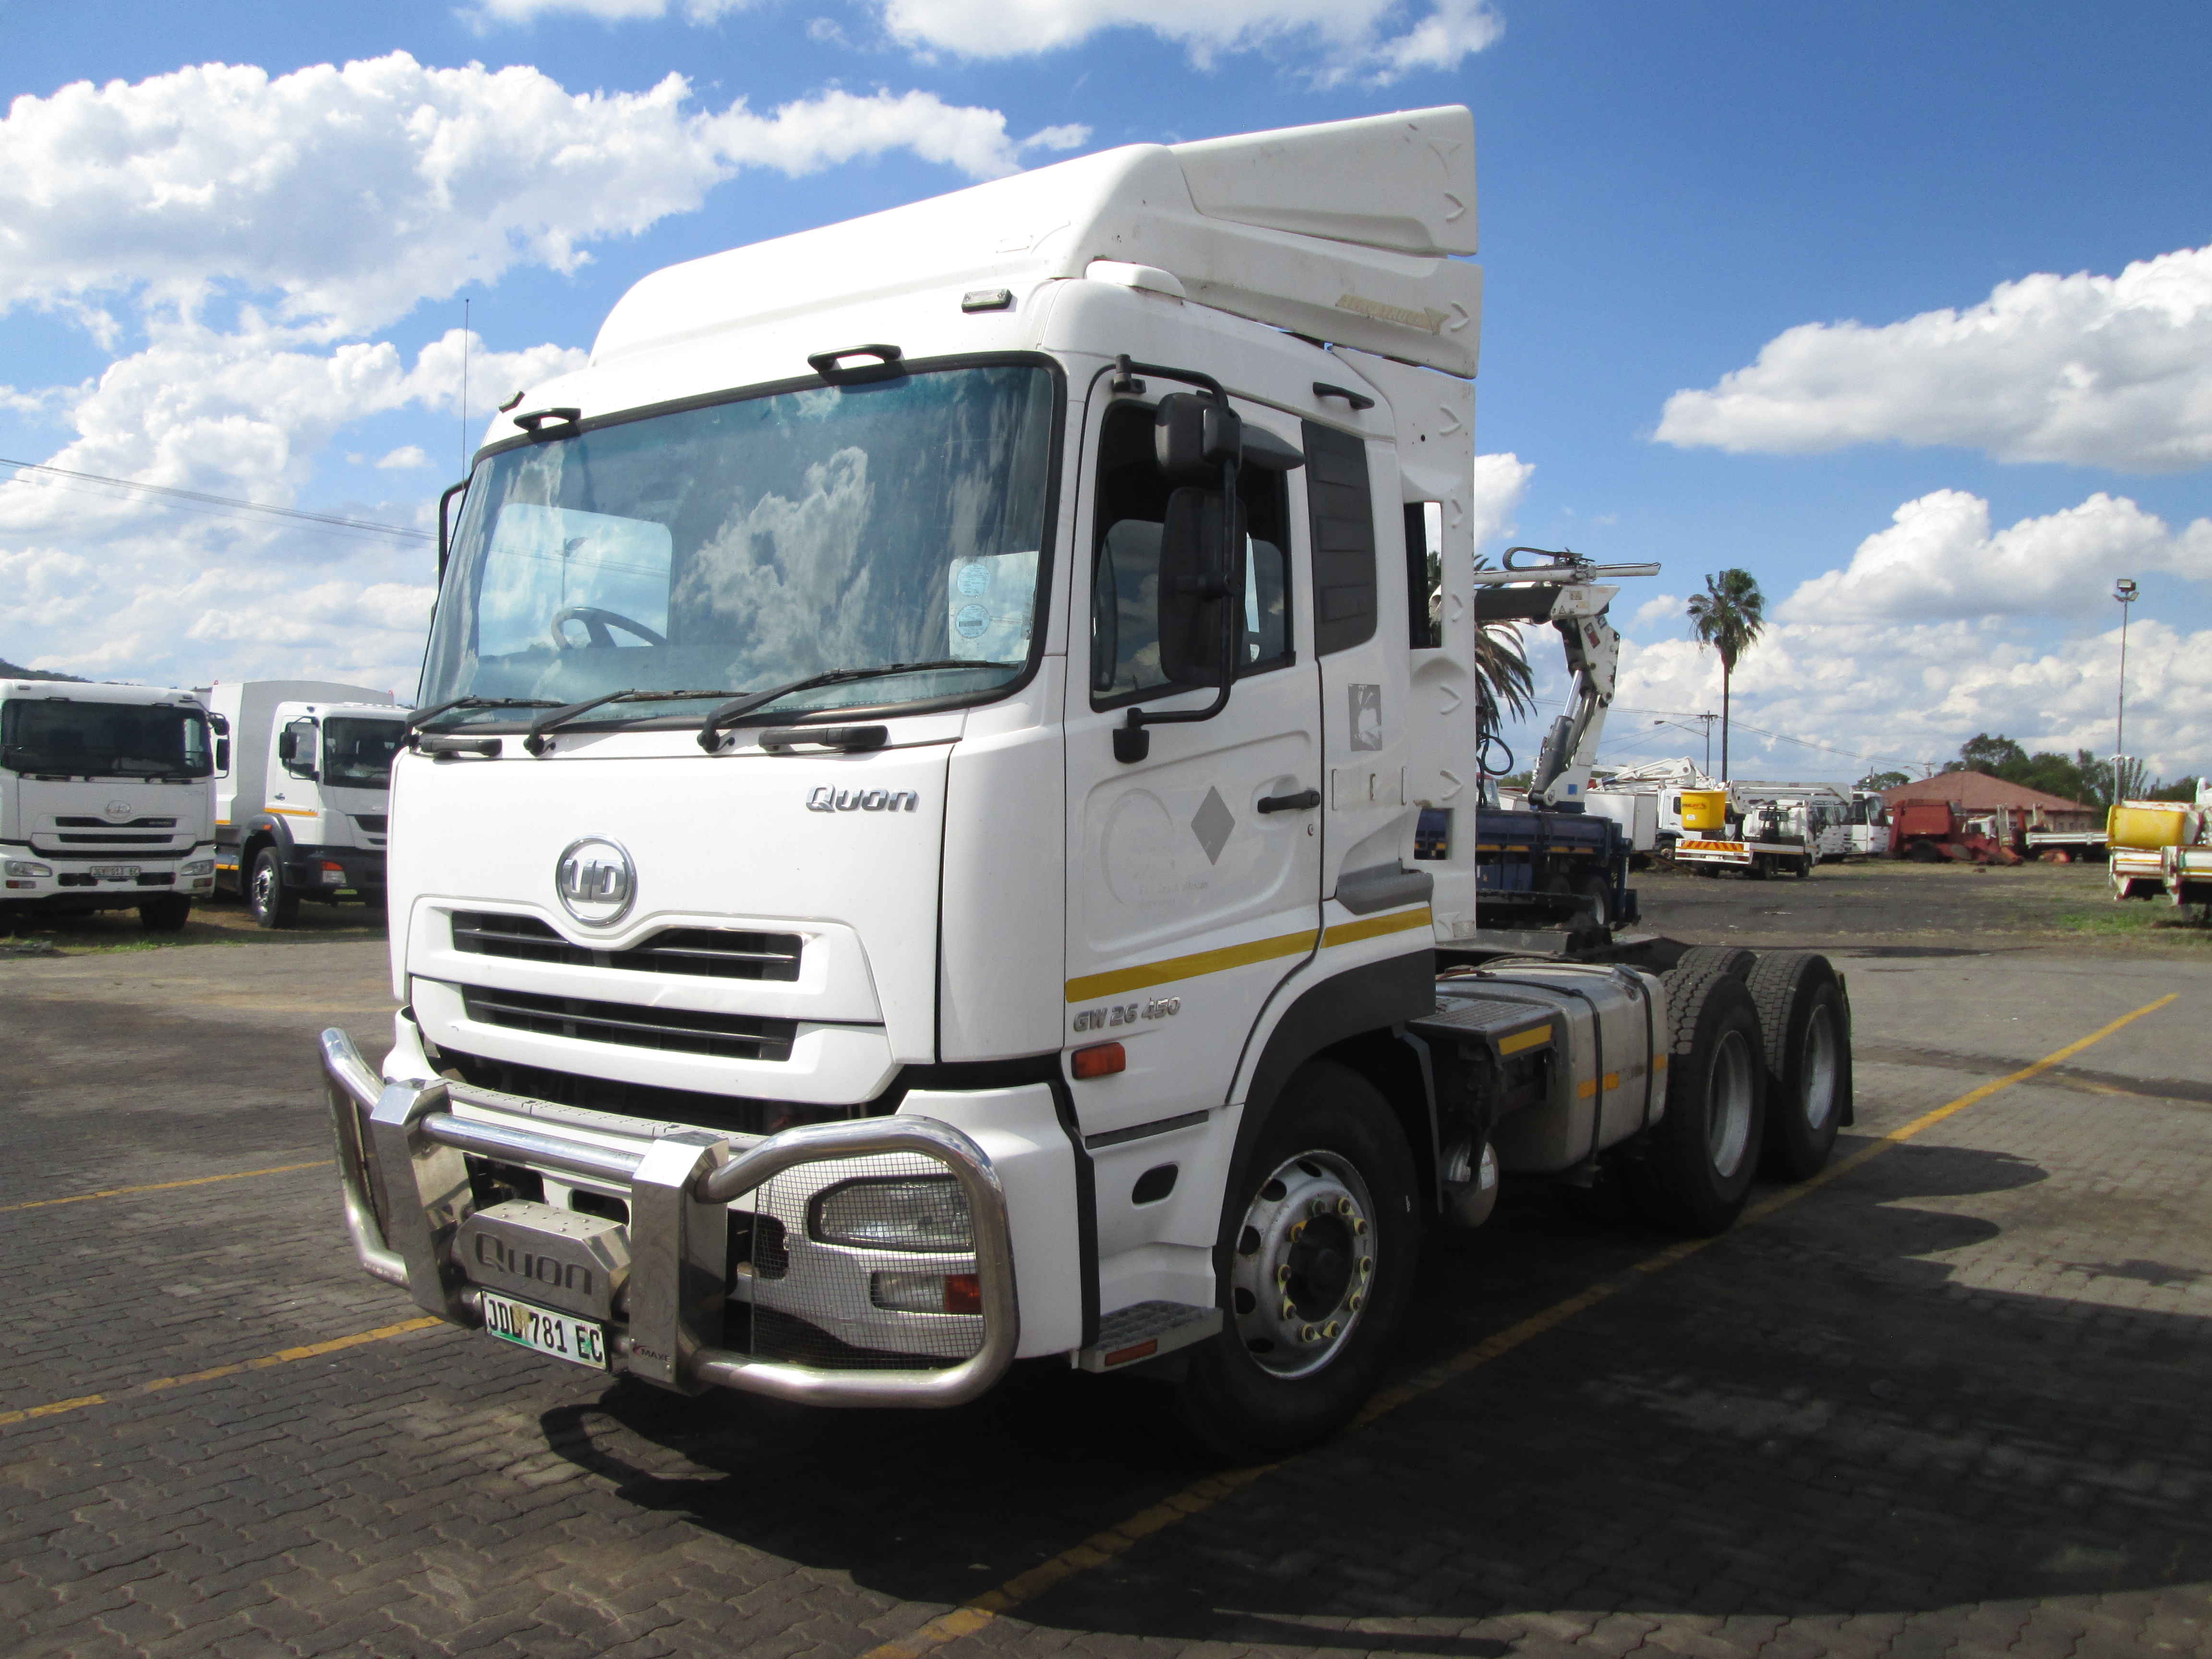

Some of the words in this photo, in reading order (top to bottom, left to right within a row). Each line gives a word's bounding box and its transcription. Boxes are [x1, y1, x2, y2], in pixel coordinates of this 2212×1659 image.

[806, 782, 919, 813] Quon
[561, 859, 625, 901] UD
[1073, 1008, 1108, 1032] GW
[1110, 1002, 1138, 1026] 26
[1142, 996, 1181, 1020] 450
[475, 1231, 592, 1295] Quon
[529, 1311, 568, 1353] 781
[576, 1324, 603, 1362] EC
